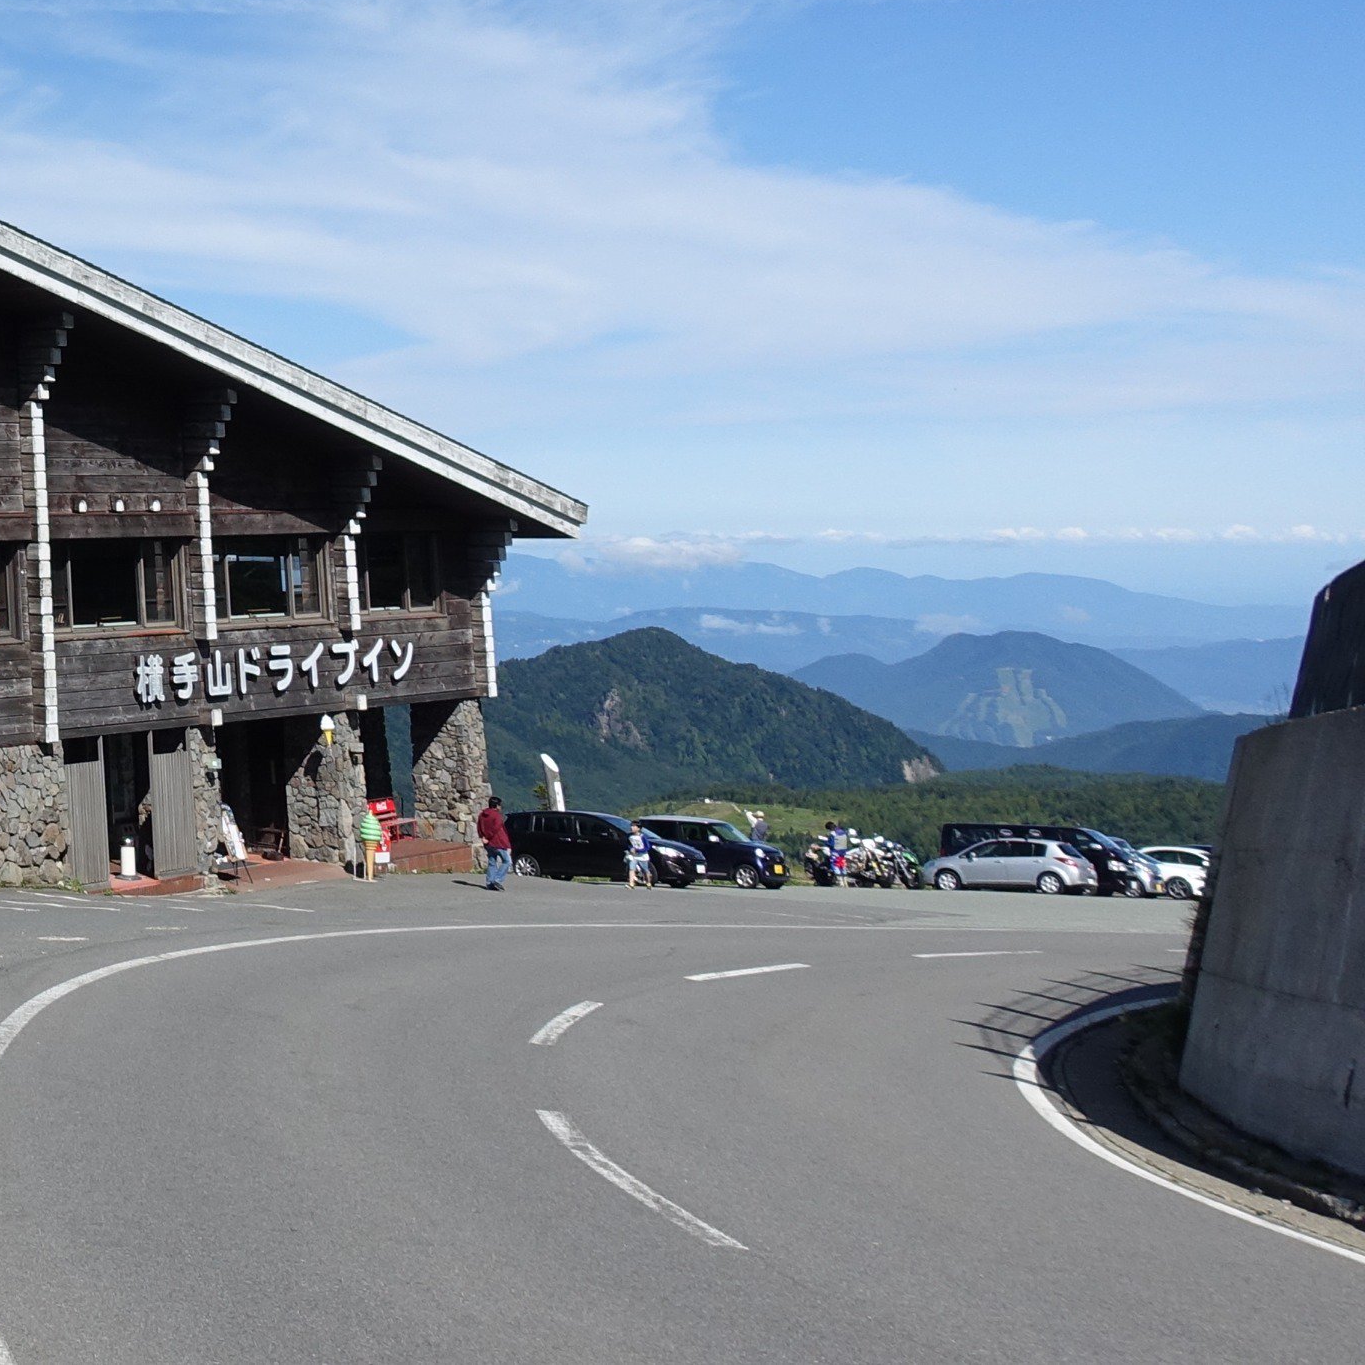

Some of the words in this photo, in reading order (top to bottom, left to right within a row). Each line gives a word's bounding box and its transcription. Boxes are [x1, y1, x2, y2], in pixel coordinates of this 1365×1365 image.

[136, 638, 413, 703] 横手山ドライブイン
